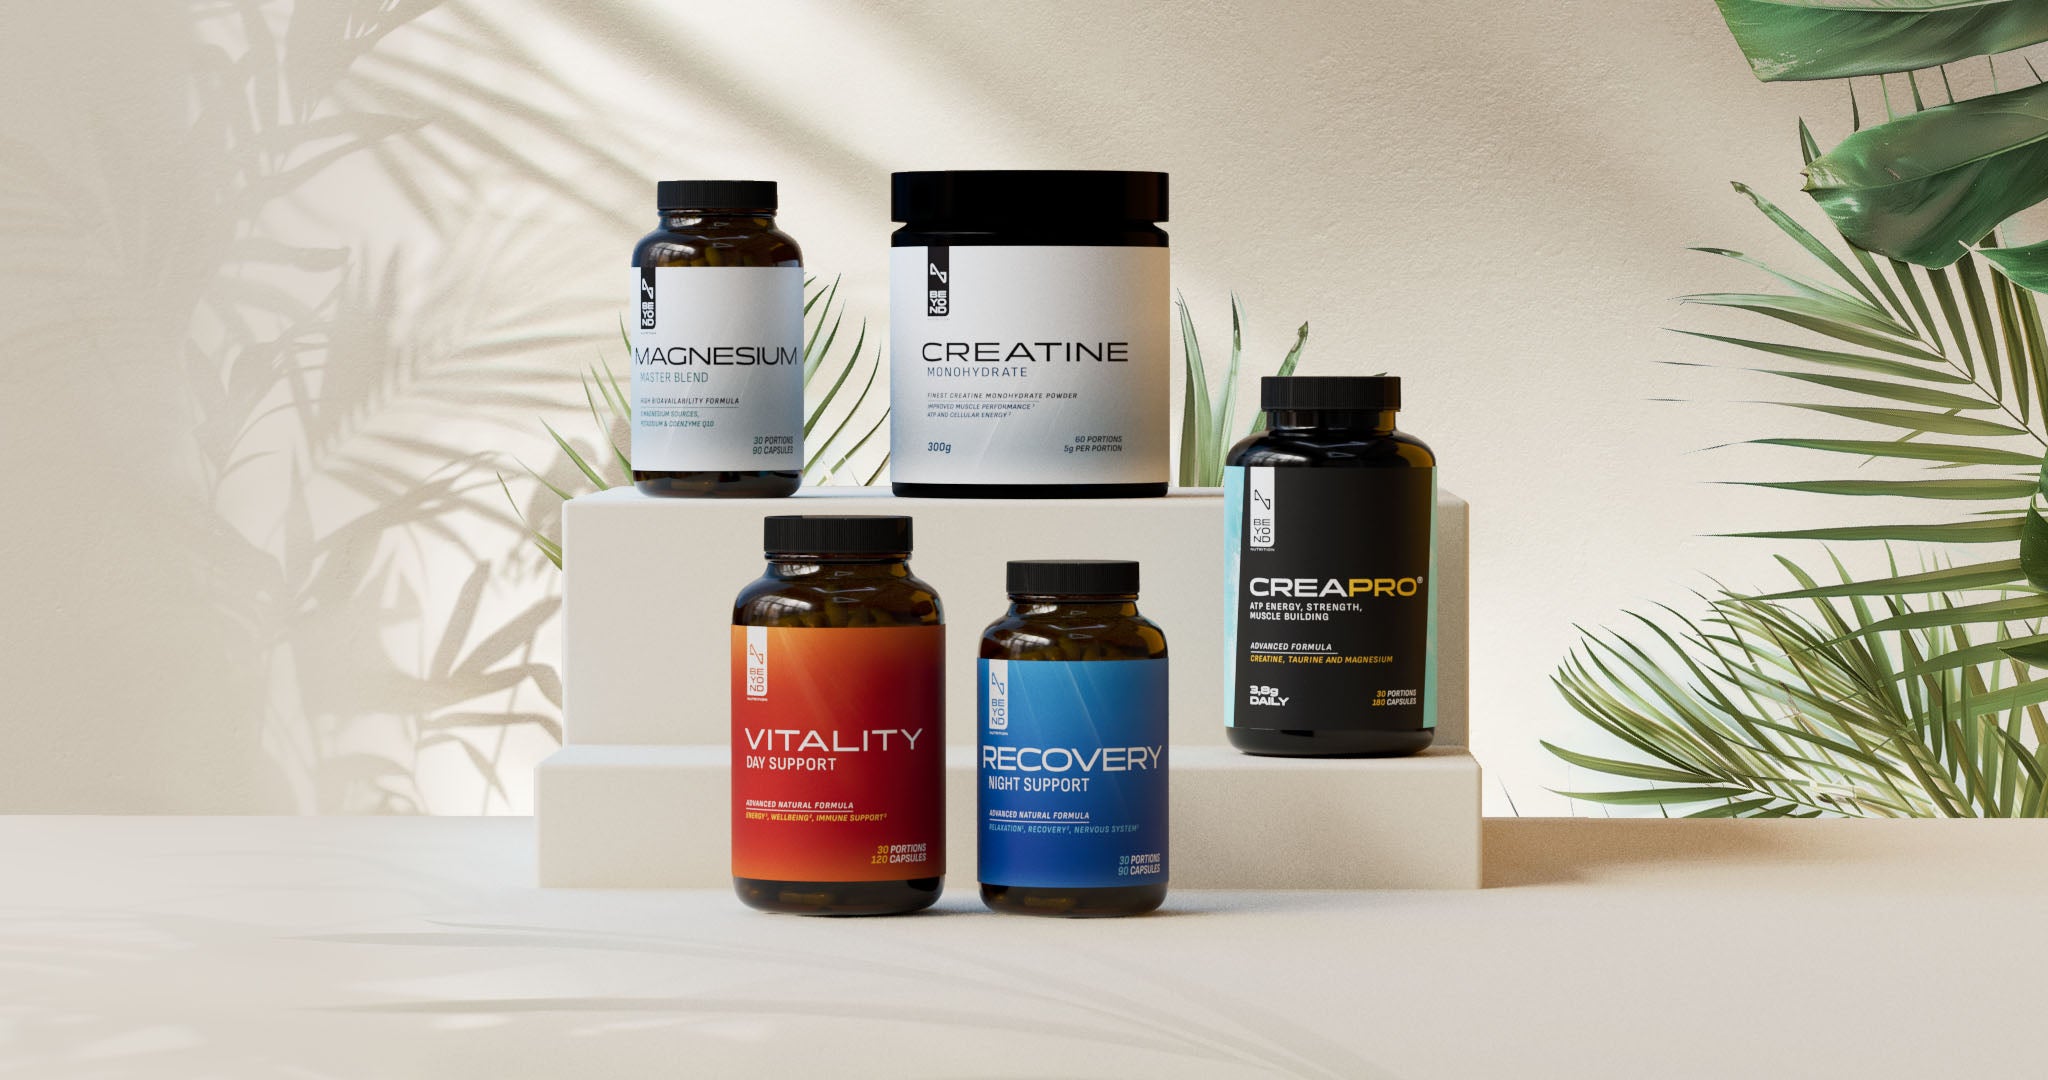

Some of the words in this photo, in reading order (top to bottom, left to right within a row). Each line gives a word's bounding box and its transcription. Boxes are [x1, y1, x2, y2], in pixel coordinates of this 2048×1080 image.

[635, 346, 798, 366] MAGNESIUM
[922, 342, 1128, 362] CREATINE
[640, 371, 671, 383] MASTER
[674, 372, 709, 383] BLEND
[928, 366, 1028, 377] MONOHYDRATE
[754, 436, 764, 445] 30
[764, 436, 794, 445] PORTIONS
[752, 446, 762, 455] 90
[764, 446, 794, 455] CAPSULES
[928, 442, 952, 454] 300g
[1064, 444, 1074, 454] 5g
[1250, 602, 1264, 610] ATP
[1266, 602, 1304, 612] ENERGY,
[1306, 603, 1362, 612] STRENGTH,
[1250, 612, 1280, 620] MUSCLE
[1284, 612, 1329, 621] BUILDING
[1250, 642, 1289, 650] ADVANCED
[1250, 655, 1285, 664] CREATINE,
[1344, 656, 1393, 664] MAGNESIUM
[1250, 685, 1279, 697] 3,8g
[1387, 689, 1417, 697] PORTIONS
[1250, 696, 1290, 706] DAILY
[1386, 698, 1417, 706] CAPSULES
[744, 728, 923, 752] VITALITY
[746, 756, 765, 769] DAY
[769, 757, 837, 771] SUPPORT
[982, 745, 1162, 772] RECOVERY
[988, 775, 1020, 791] NIGHT
[1023, 777, 1090, 792] SUPPORT
[746, 799, 776, 808] ADVANCED
[778, 800, 812, 809] NATURAL
[989, 809, 1018, 818] ADVANCED
[1019, 811, 1050, 819] NATURAL
[877, 845, 889, 854] 30
[890, 843, 926, 854] PORTIONS
[870, 855, 888, 864] 120
[889, 853, 926, 864] CAPSULES
[1119, 855, 1129, 865] 30
[1131, 853, 1160, 864] PORTIONS
[1118, 866, 1129, 876] 90
[1130, 864, 1160, 876] CAPSULES
